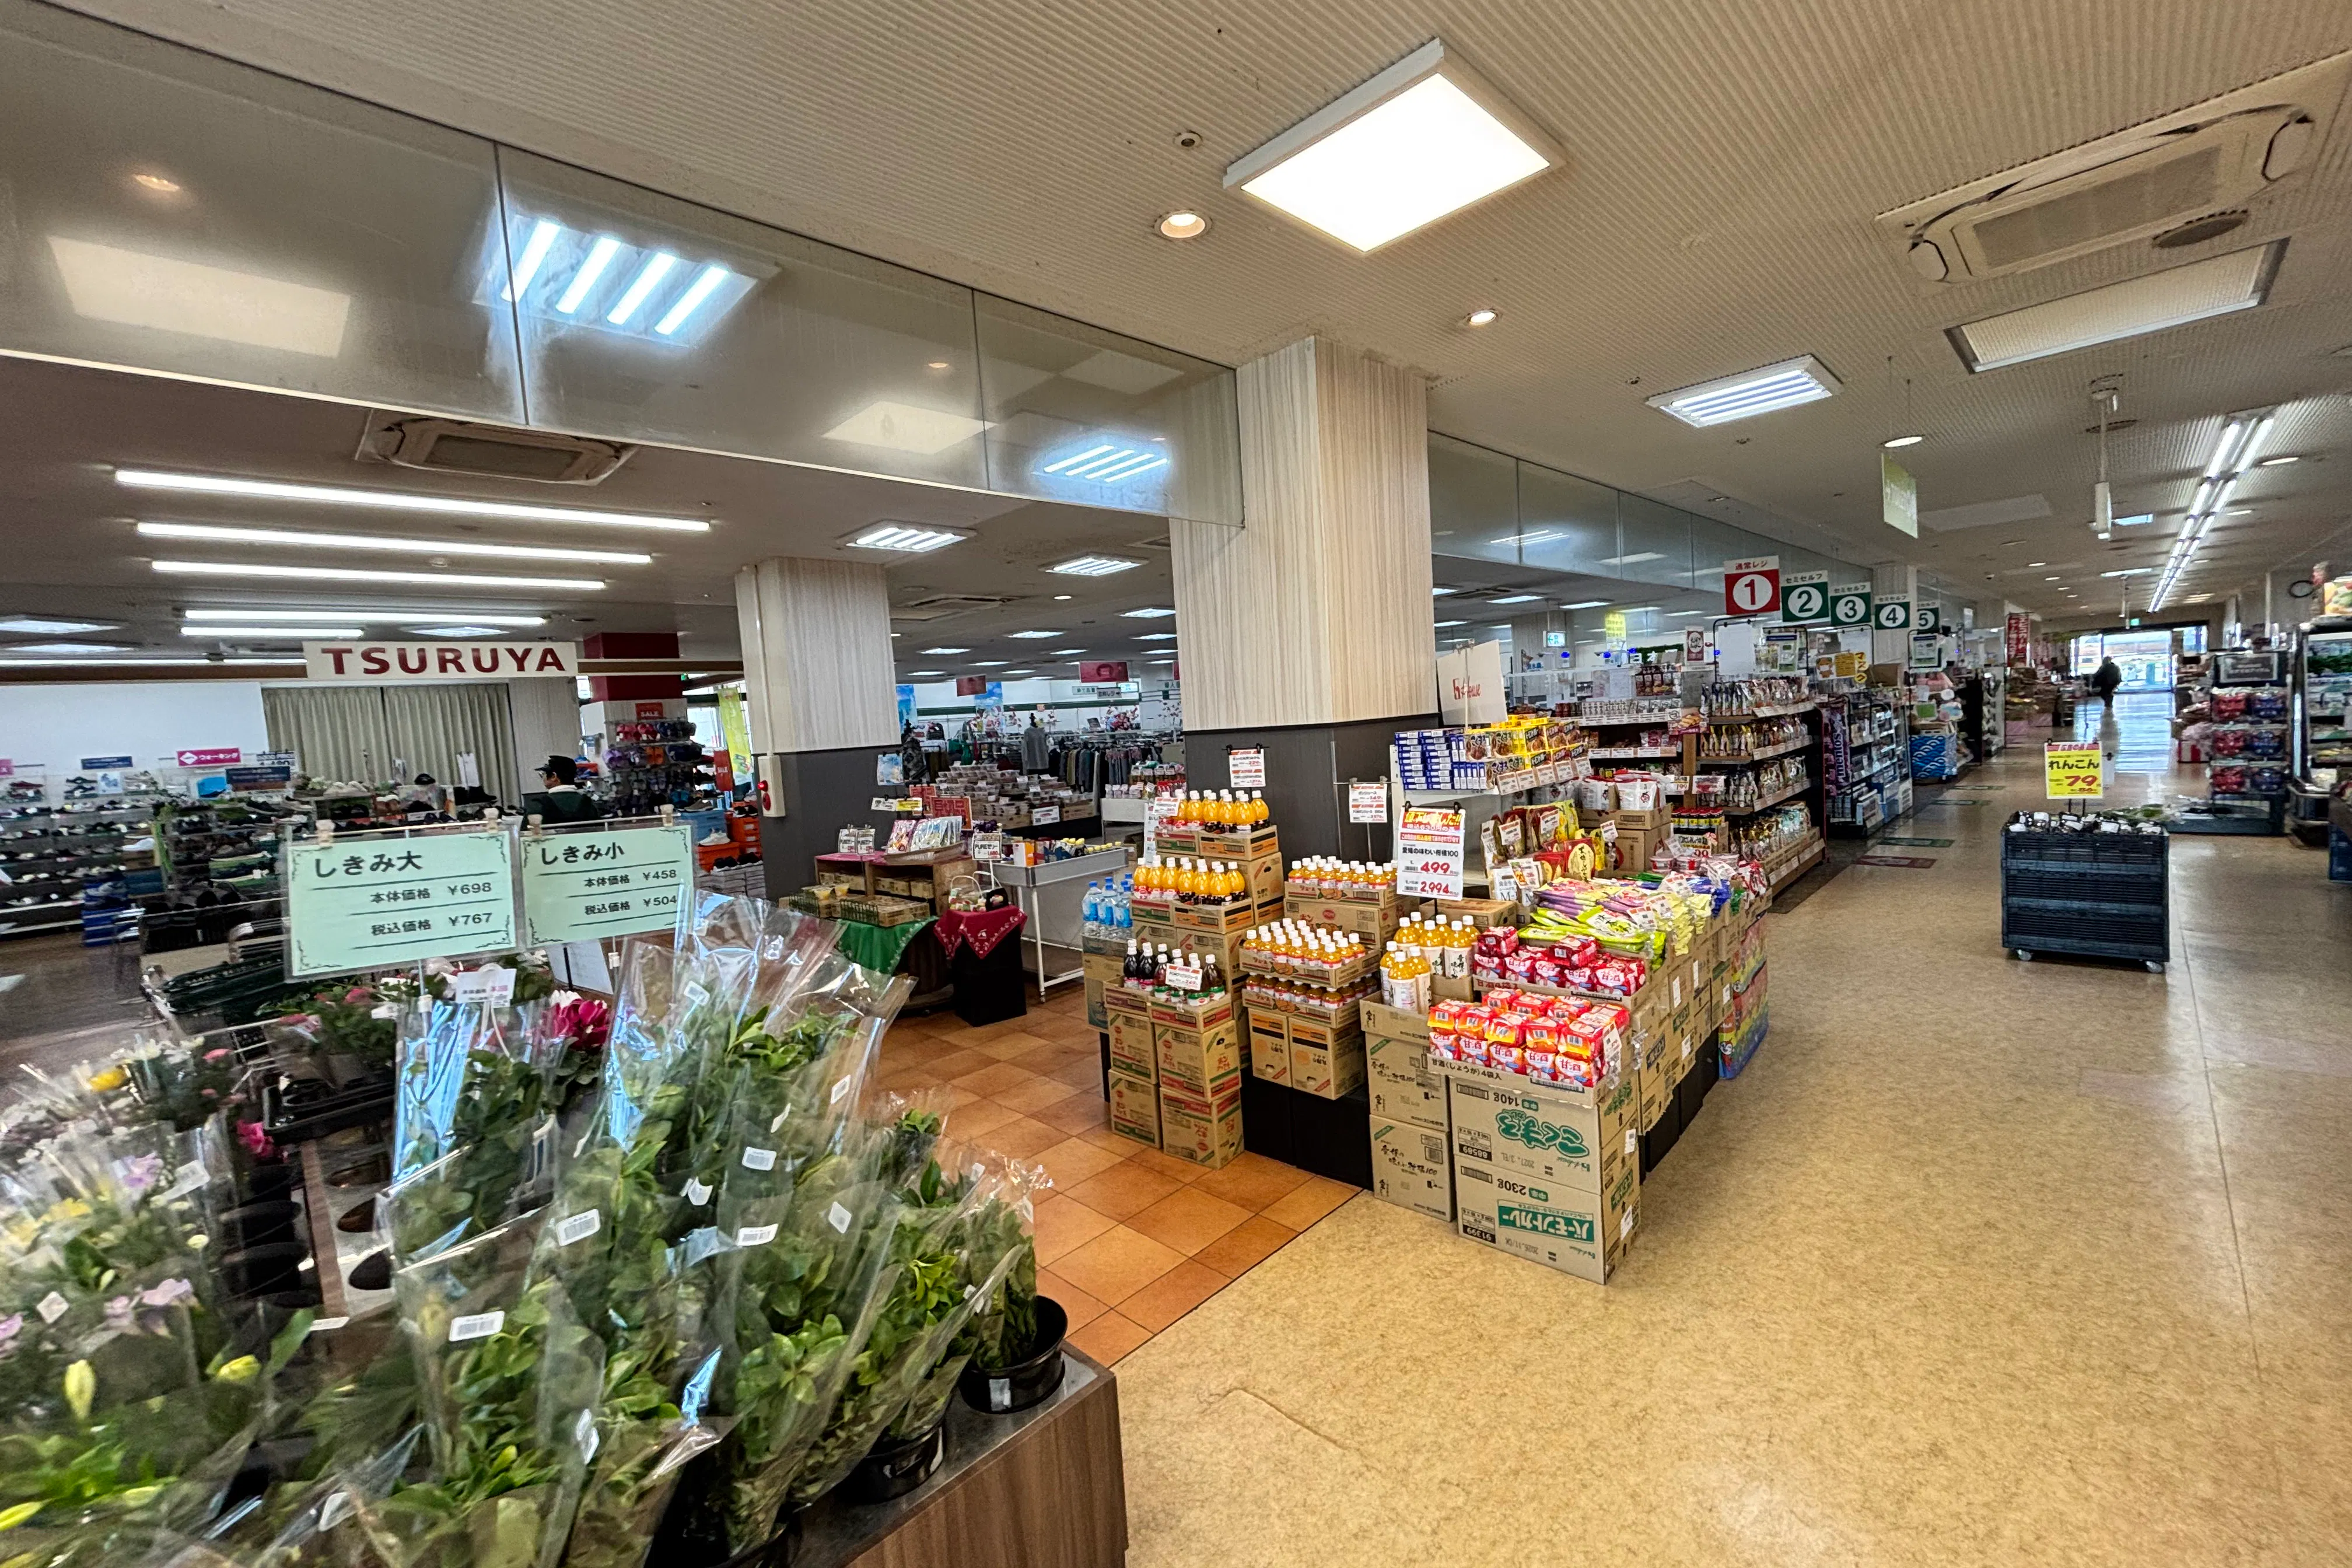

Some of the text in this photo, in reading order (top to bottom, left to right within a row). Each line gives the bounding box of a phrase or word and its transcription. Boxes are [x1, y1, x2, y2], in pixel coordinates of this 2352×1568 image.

[1735, 561, 1768, 570] 通常レジ
[1786, 573, 1822, 583] セミセルフ
[1744, 579, 1756, 606] 1
[1833, 585, 1866, 593] セミセルフ
[1797, 590, 1814, 613] 2
[1844, 599, 1857, 619] 3
[1885, 607, 1898, 624] 4
[1919, 613, 1929, 626] 5
[321, 648, 565, 674] TSURUYA
[1833, 733, 1845, 779] mentos
[2048, 759, 2099, 770] れんこん
[2064, 775, 2098, 786] 79
[541, 842, 625, 865] しきみ小
[315, 850, 423, 878] しきみ大
[1420, 861, 1450, 874] 499
[584, 869, 677, 888] 本体価格 ¥458
[370, 882, 492, 904] 本体価格 ¥698
[585, 895, 677, 915] 税込価格 ¥504
[371, 912, 492, 936] 税込価格 ¥767
[1477, 980, 1517, 990] 甘酒4袋
[1432, 1058, 1503, 1080] 甘酒(しょうが)4袋入
[1560, 1059, 1581, 1072] 甘酒
[1493, 1091, 1520, 1107] 140g
[1496, 1112, 1590, 1158] こくまろ
[1462, 1145, 1488, 1159] 88589
[1497, 1178, 1527, 1196] 230g
[1466, 1227, 1492, 1241] 91399
[1502, 1210, 1590, 1240] バーモントカレー
